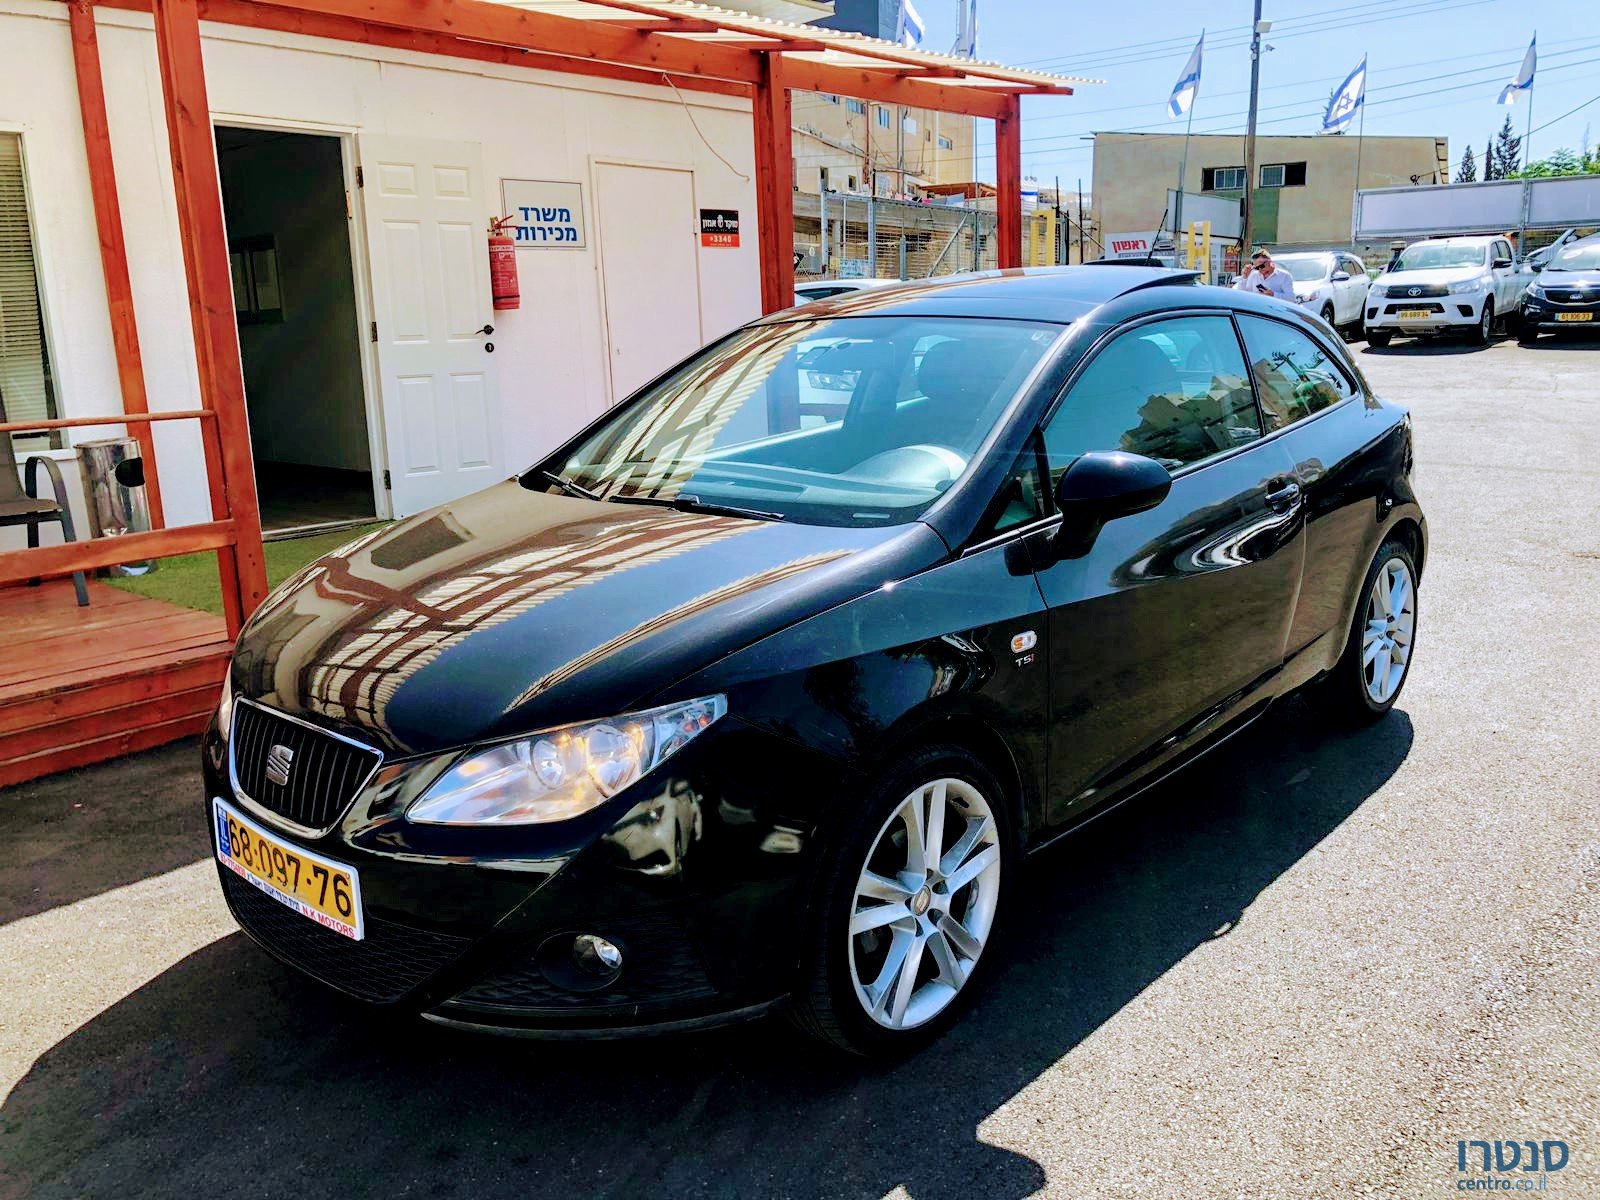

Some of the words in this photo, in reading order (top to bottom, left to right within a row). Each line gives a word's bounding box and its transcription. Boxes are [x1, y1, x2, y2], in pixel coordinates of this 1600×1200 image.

[518, 206, 571, 222] משרד
[515, 226, 578, 241] מכירות
[1111, 239, 1148, 253] ראשון
[317, 914, 356, 938] MOTORS
